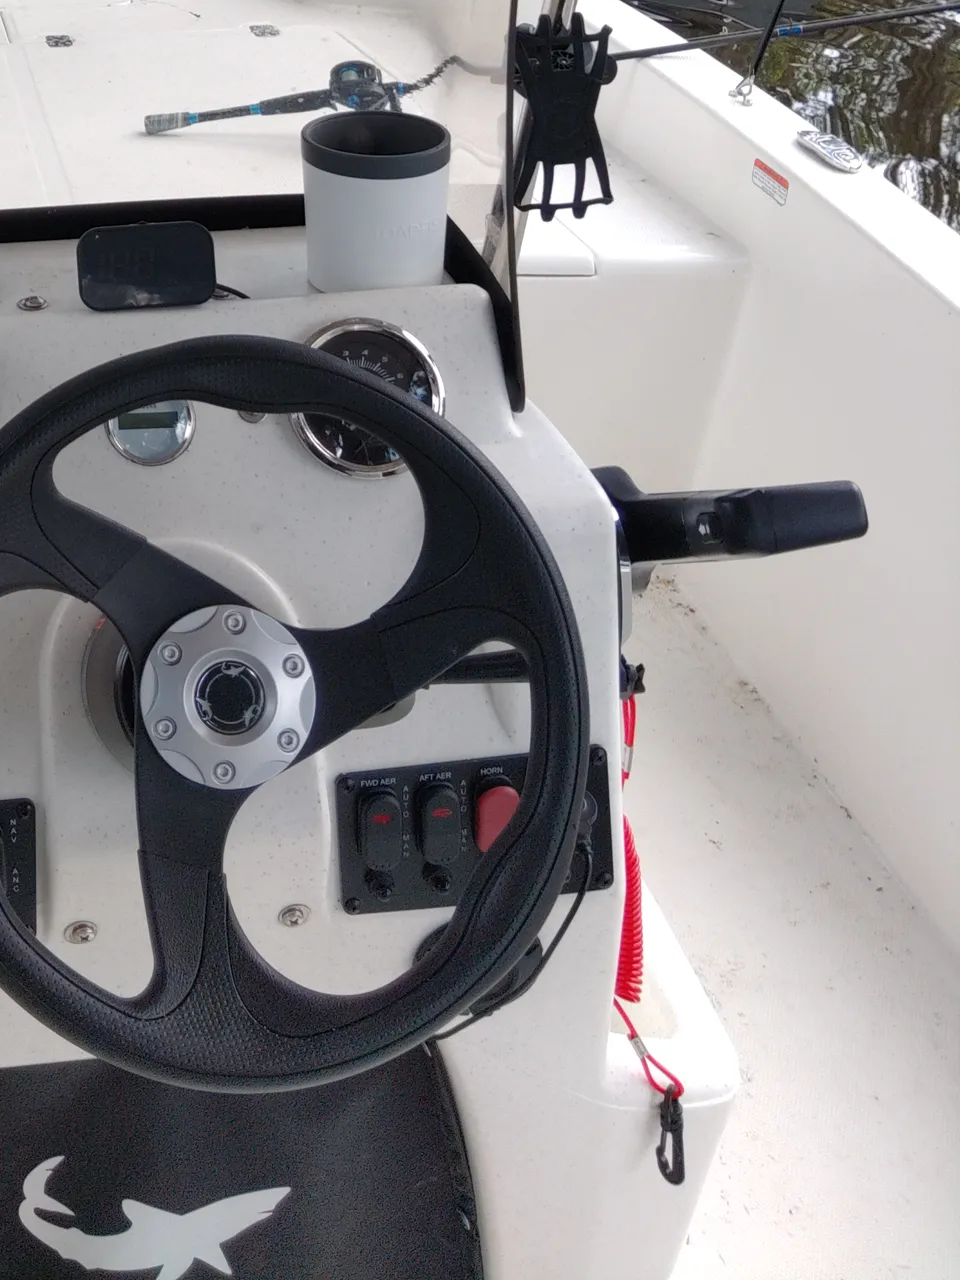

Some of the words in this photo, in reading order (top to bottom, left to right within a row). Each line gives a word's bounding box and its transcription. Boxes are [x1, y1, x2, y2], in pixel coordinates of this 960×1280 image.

[480, 767, 503, 775] HORN
[419, 773, 434, 781] AFT
[435, 772, 451, 780] AER
[380, 777, 396, 785] AER
